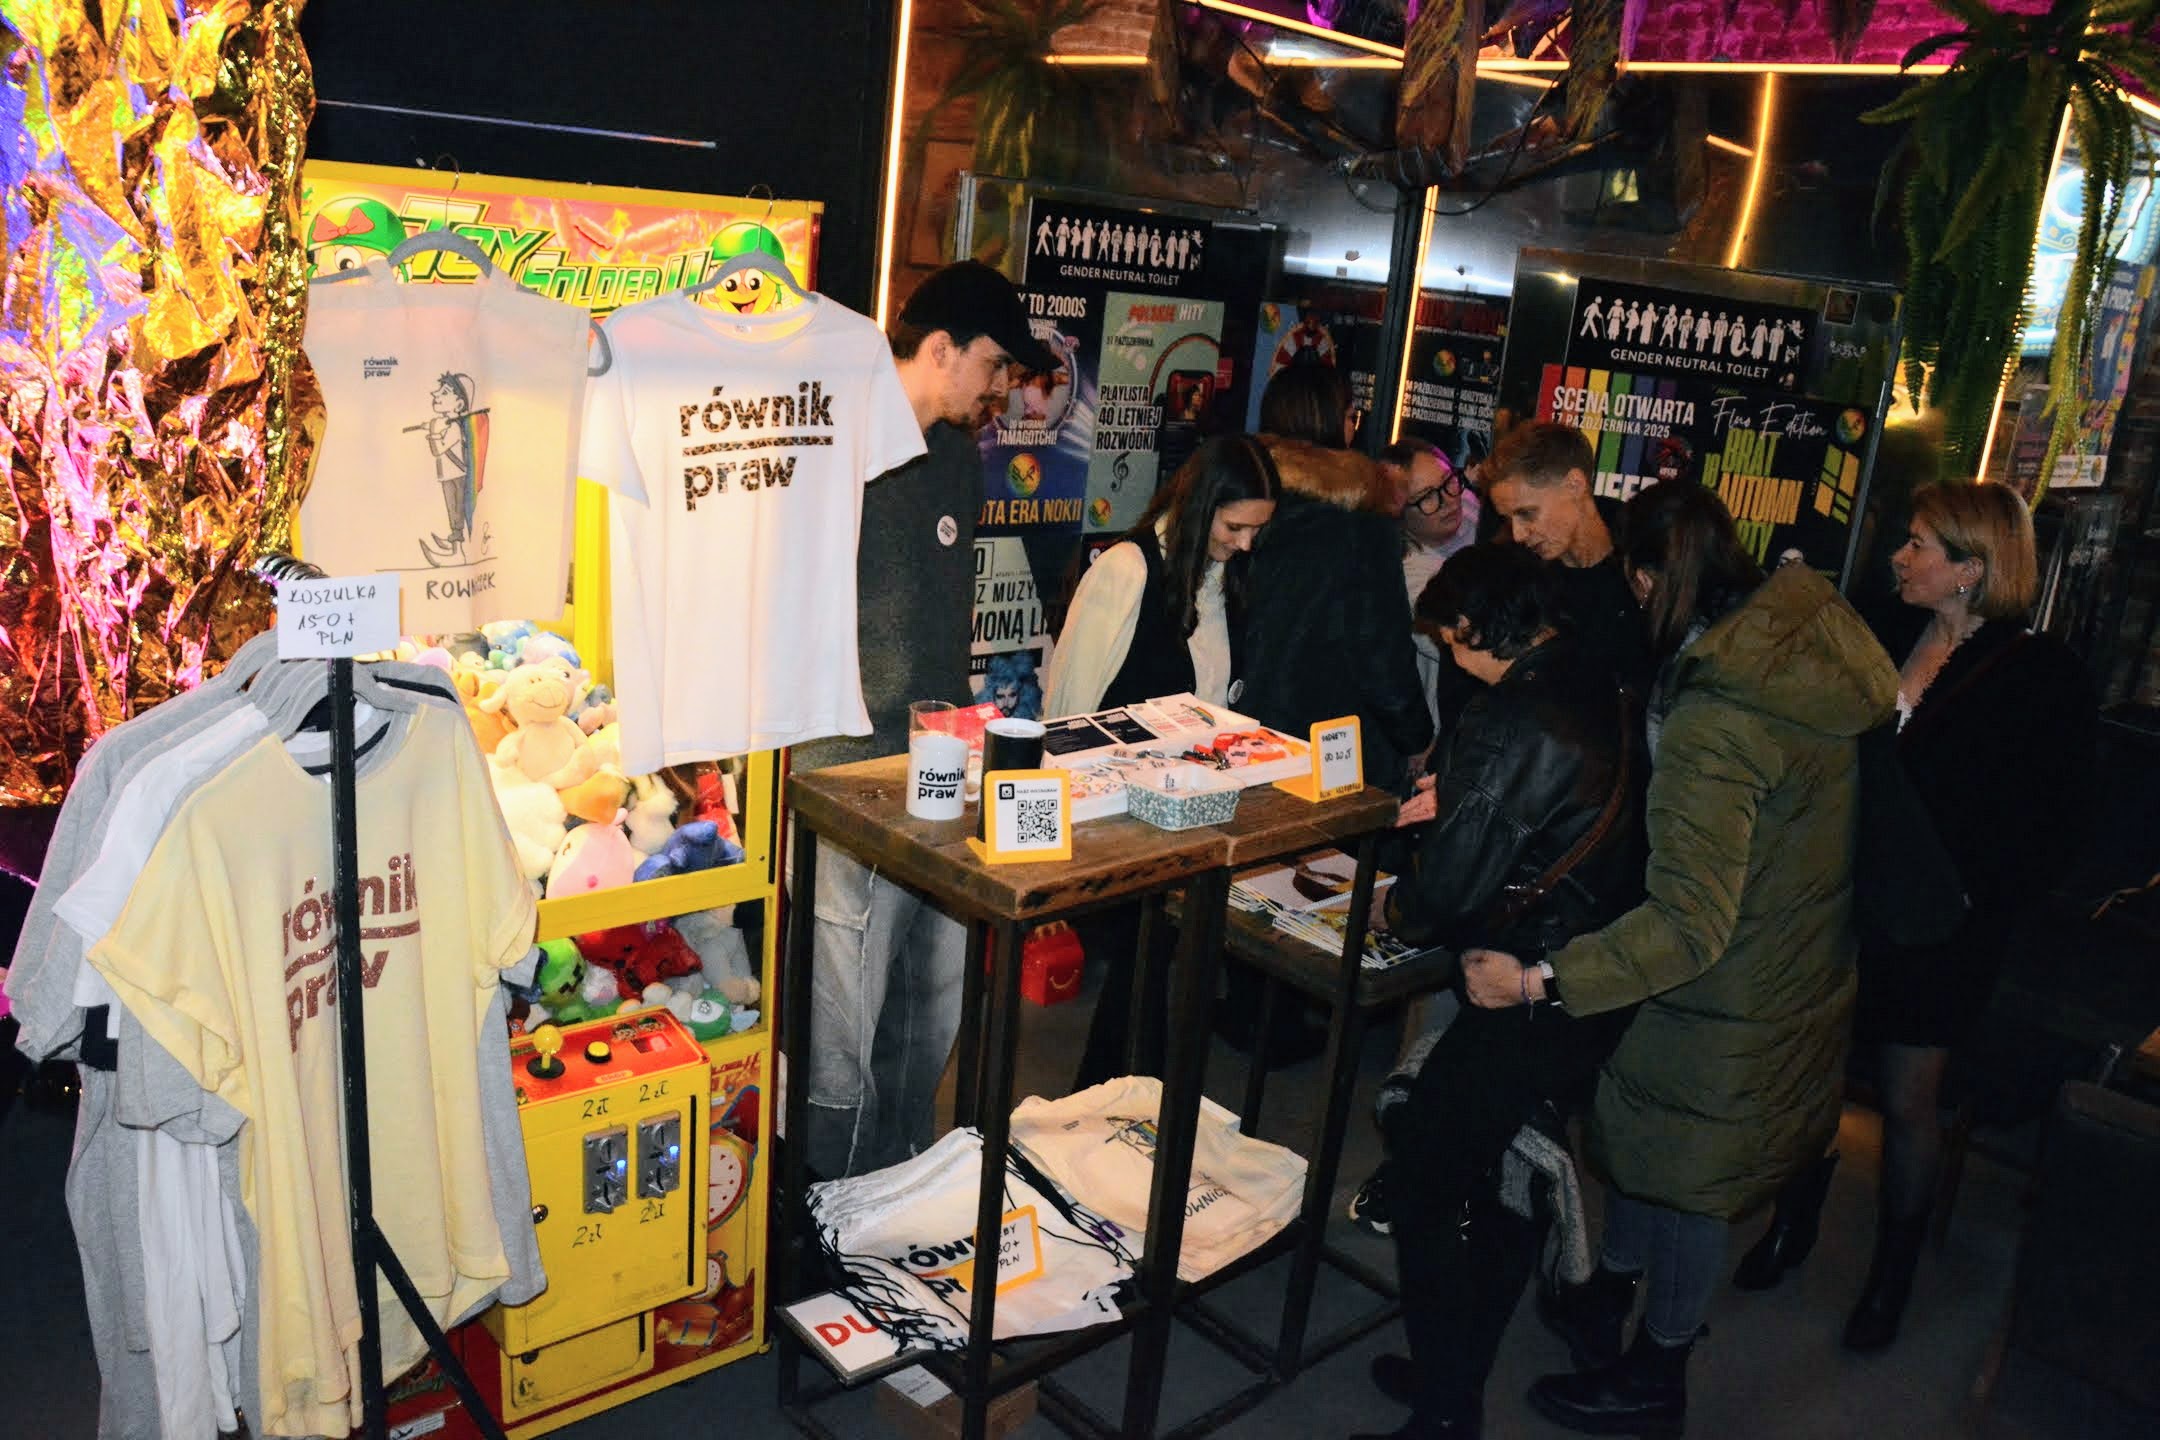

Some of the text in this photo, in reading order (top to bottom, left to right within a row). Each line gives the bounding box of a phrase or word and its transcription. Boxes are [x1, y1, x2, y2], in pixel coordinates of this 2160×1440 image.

[1060, 265, 1180, 286] GENDER NEUTRAL TOILET
[1028, 293, 1045, 315] TO
[1047, 295, 1087, 318] 2000S
[363, 356, 398, 366] równik
[1610, 348, 1769, 380] GENDER NEUTRAL TOILET
[364, 370, 391, 379] praw
[1101, 385, 1149, 402] PLAYLISTA
[680, 381, 834, 437] równik
[1552, 385, 1696, 426] SCENA OTWARTA
[1096, 429, 1155, 450] ROZWÓDKI
[1643, 423, 1670, 439] 2025
[1721, 427, 1781, 478] BRAT
[684, 455, 798, 511] praw
[1009, 499, 1039, 525] ERA
[288, 585, 376, 605] KOSZULKA
[316, 631, 354, 646] PLN
[919, 767, 966, 782] równik
[918, 787, 957, 800] praw
[999, 1253, 1020, 1270] PLN
